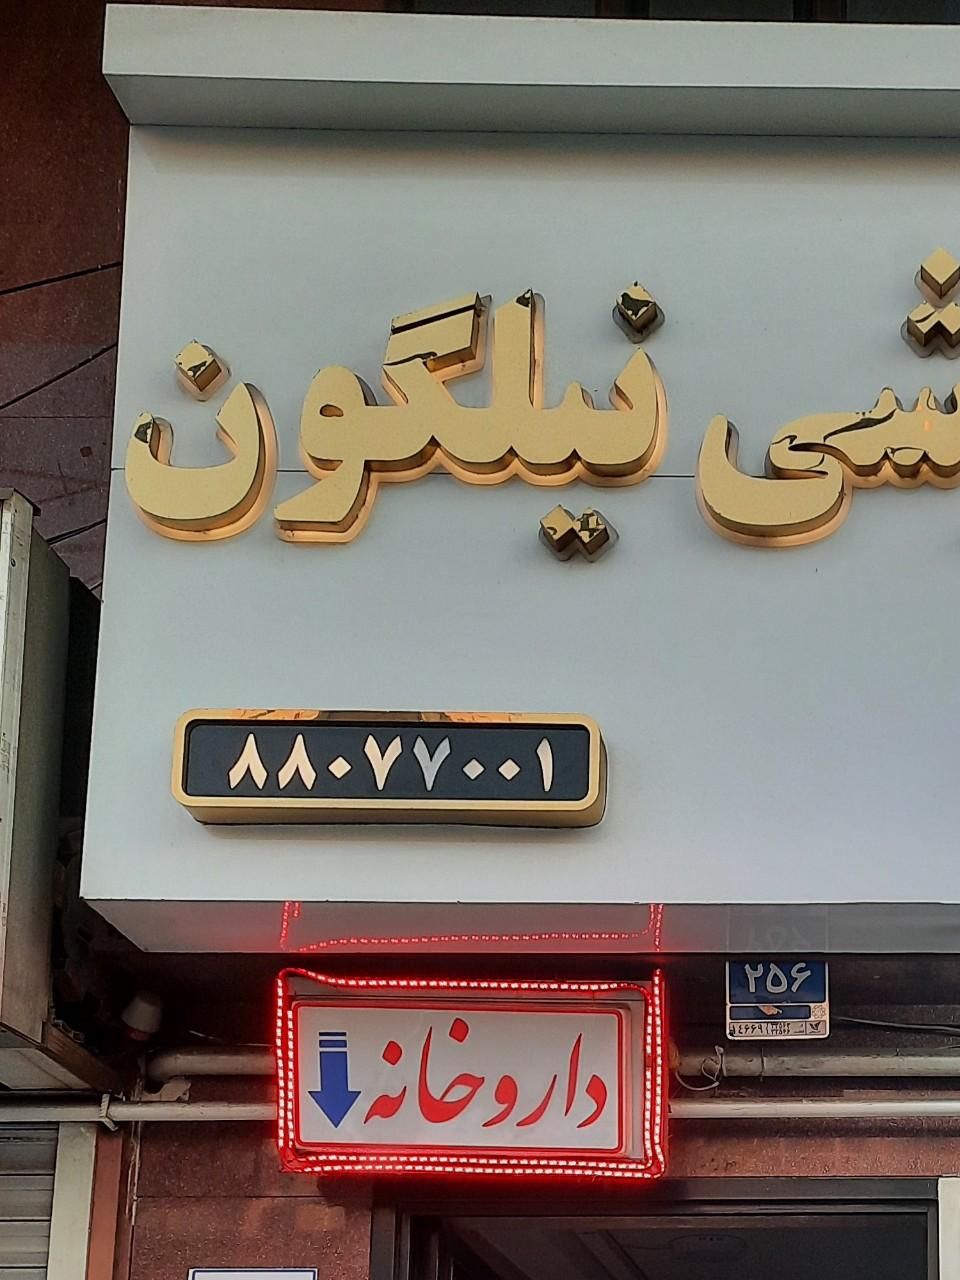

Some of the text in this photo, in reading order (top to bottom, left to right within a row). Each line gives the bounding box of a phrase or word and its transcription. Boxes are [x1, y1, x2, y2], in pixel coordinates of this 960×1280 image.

[126, 281, 666, 562] نیلگون
[228, 732, 554, 792] ۸۸۰۷۷۰۰۱
[744, 962, 812, 994] ۲۵۶
[363, 1017, 608, 1129] داروخانه
